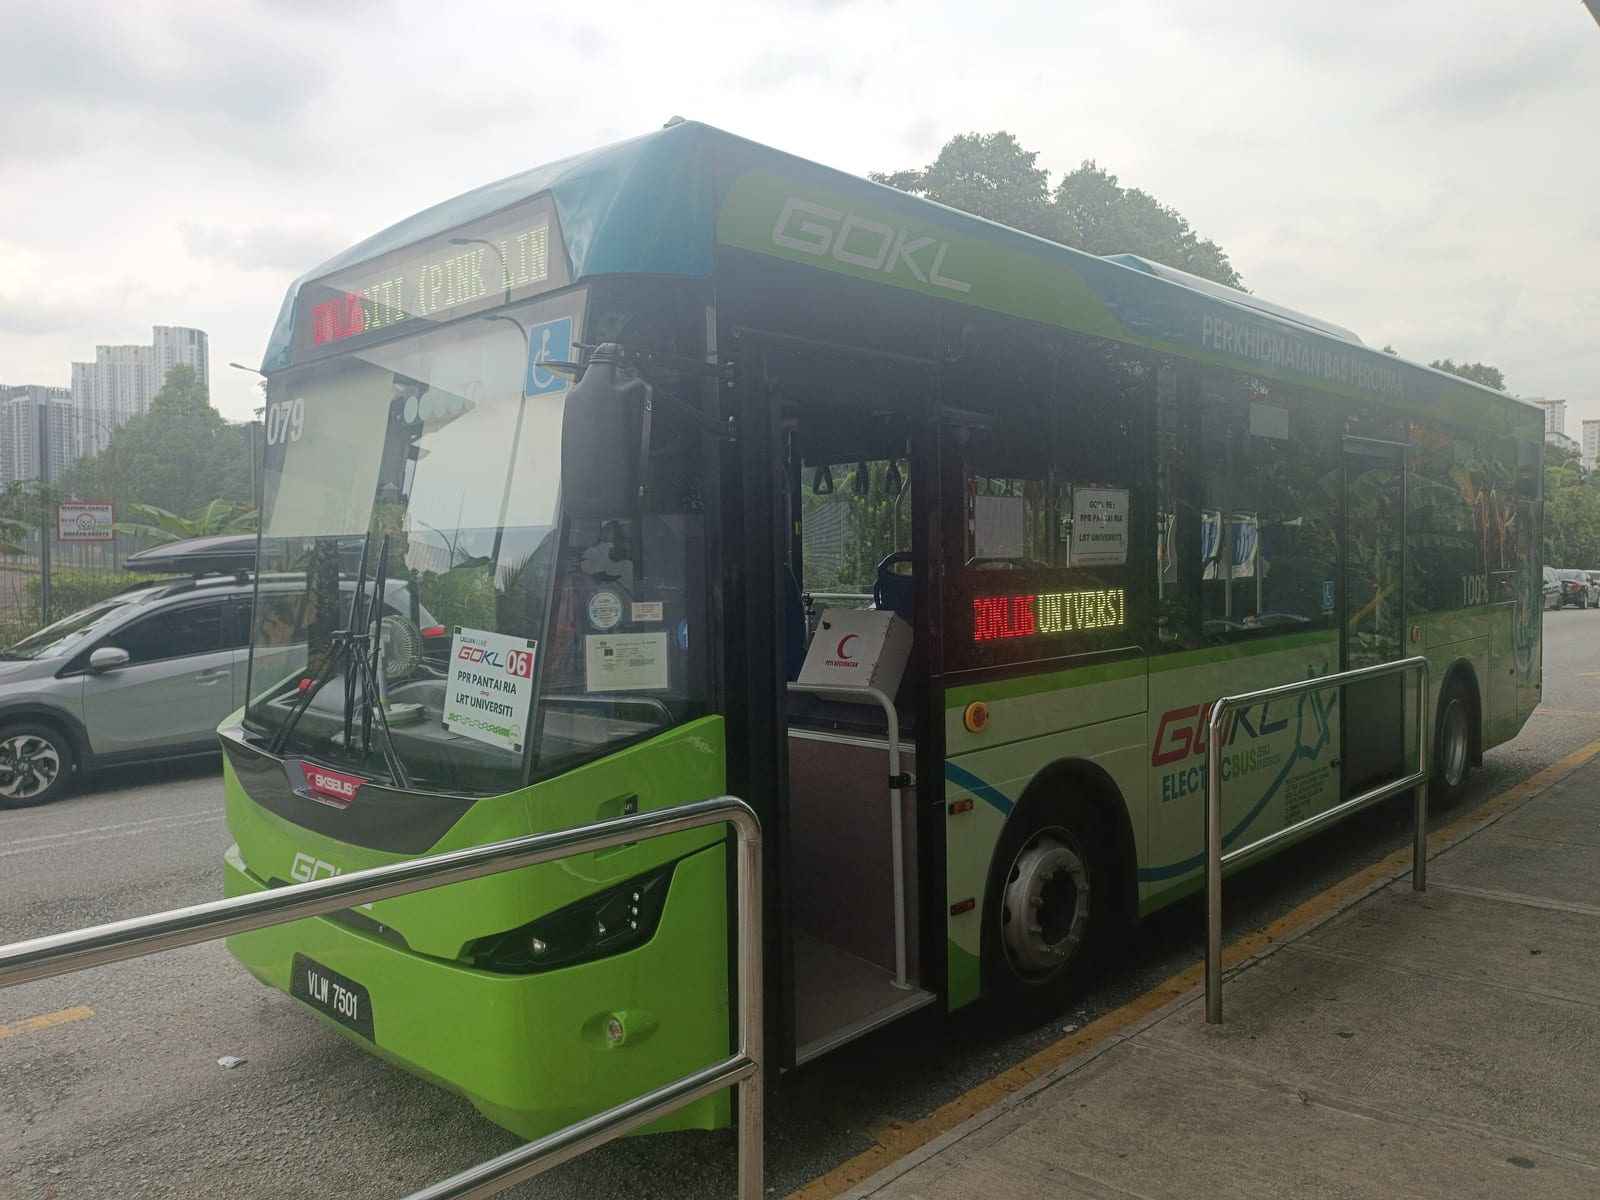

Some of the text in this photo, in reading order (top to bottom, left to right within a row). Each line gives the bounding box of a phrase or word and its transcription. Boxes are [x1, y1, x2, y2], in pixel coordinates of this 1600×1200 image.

[772, 198, 972, 293] GOKL
[419, 248, 487, 316] (PINK
[1202, 313, 1404, 395] PERKHIDMATAN BAS PERCUMA
[267, 398, 305, 446] 079
[1038, 589, 1125, 633] UNIVERSI
[1462, 575, 1489, 606] 100%
[457, 670, 517, 695] PPR PANTAI RIA
[458, 645, 528, 676] GOKL 06
[456, 692, 514, 718] LRT UNIVERSITI
[315, 774, 354, 796] SKSBUS
[307, 969, 358, 1020] VLW 7501
